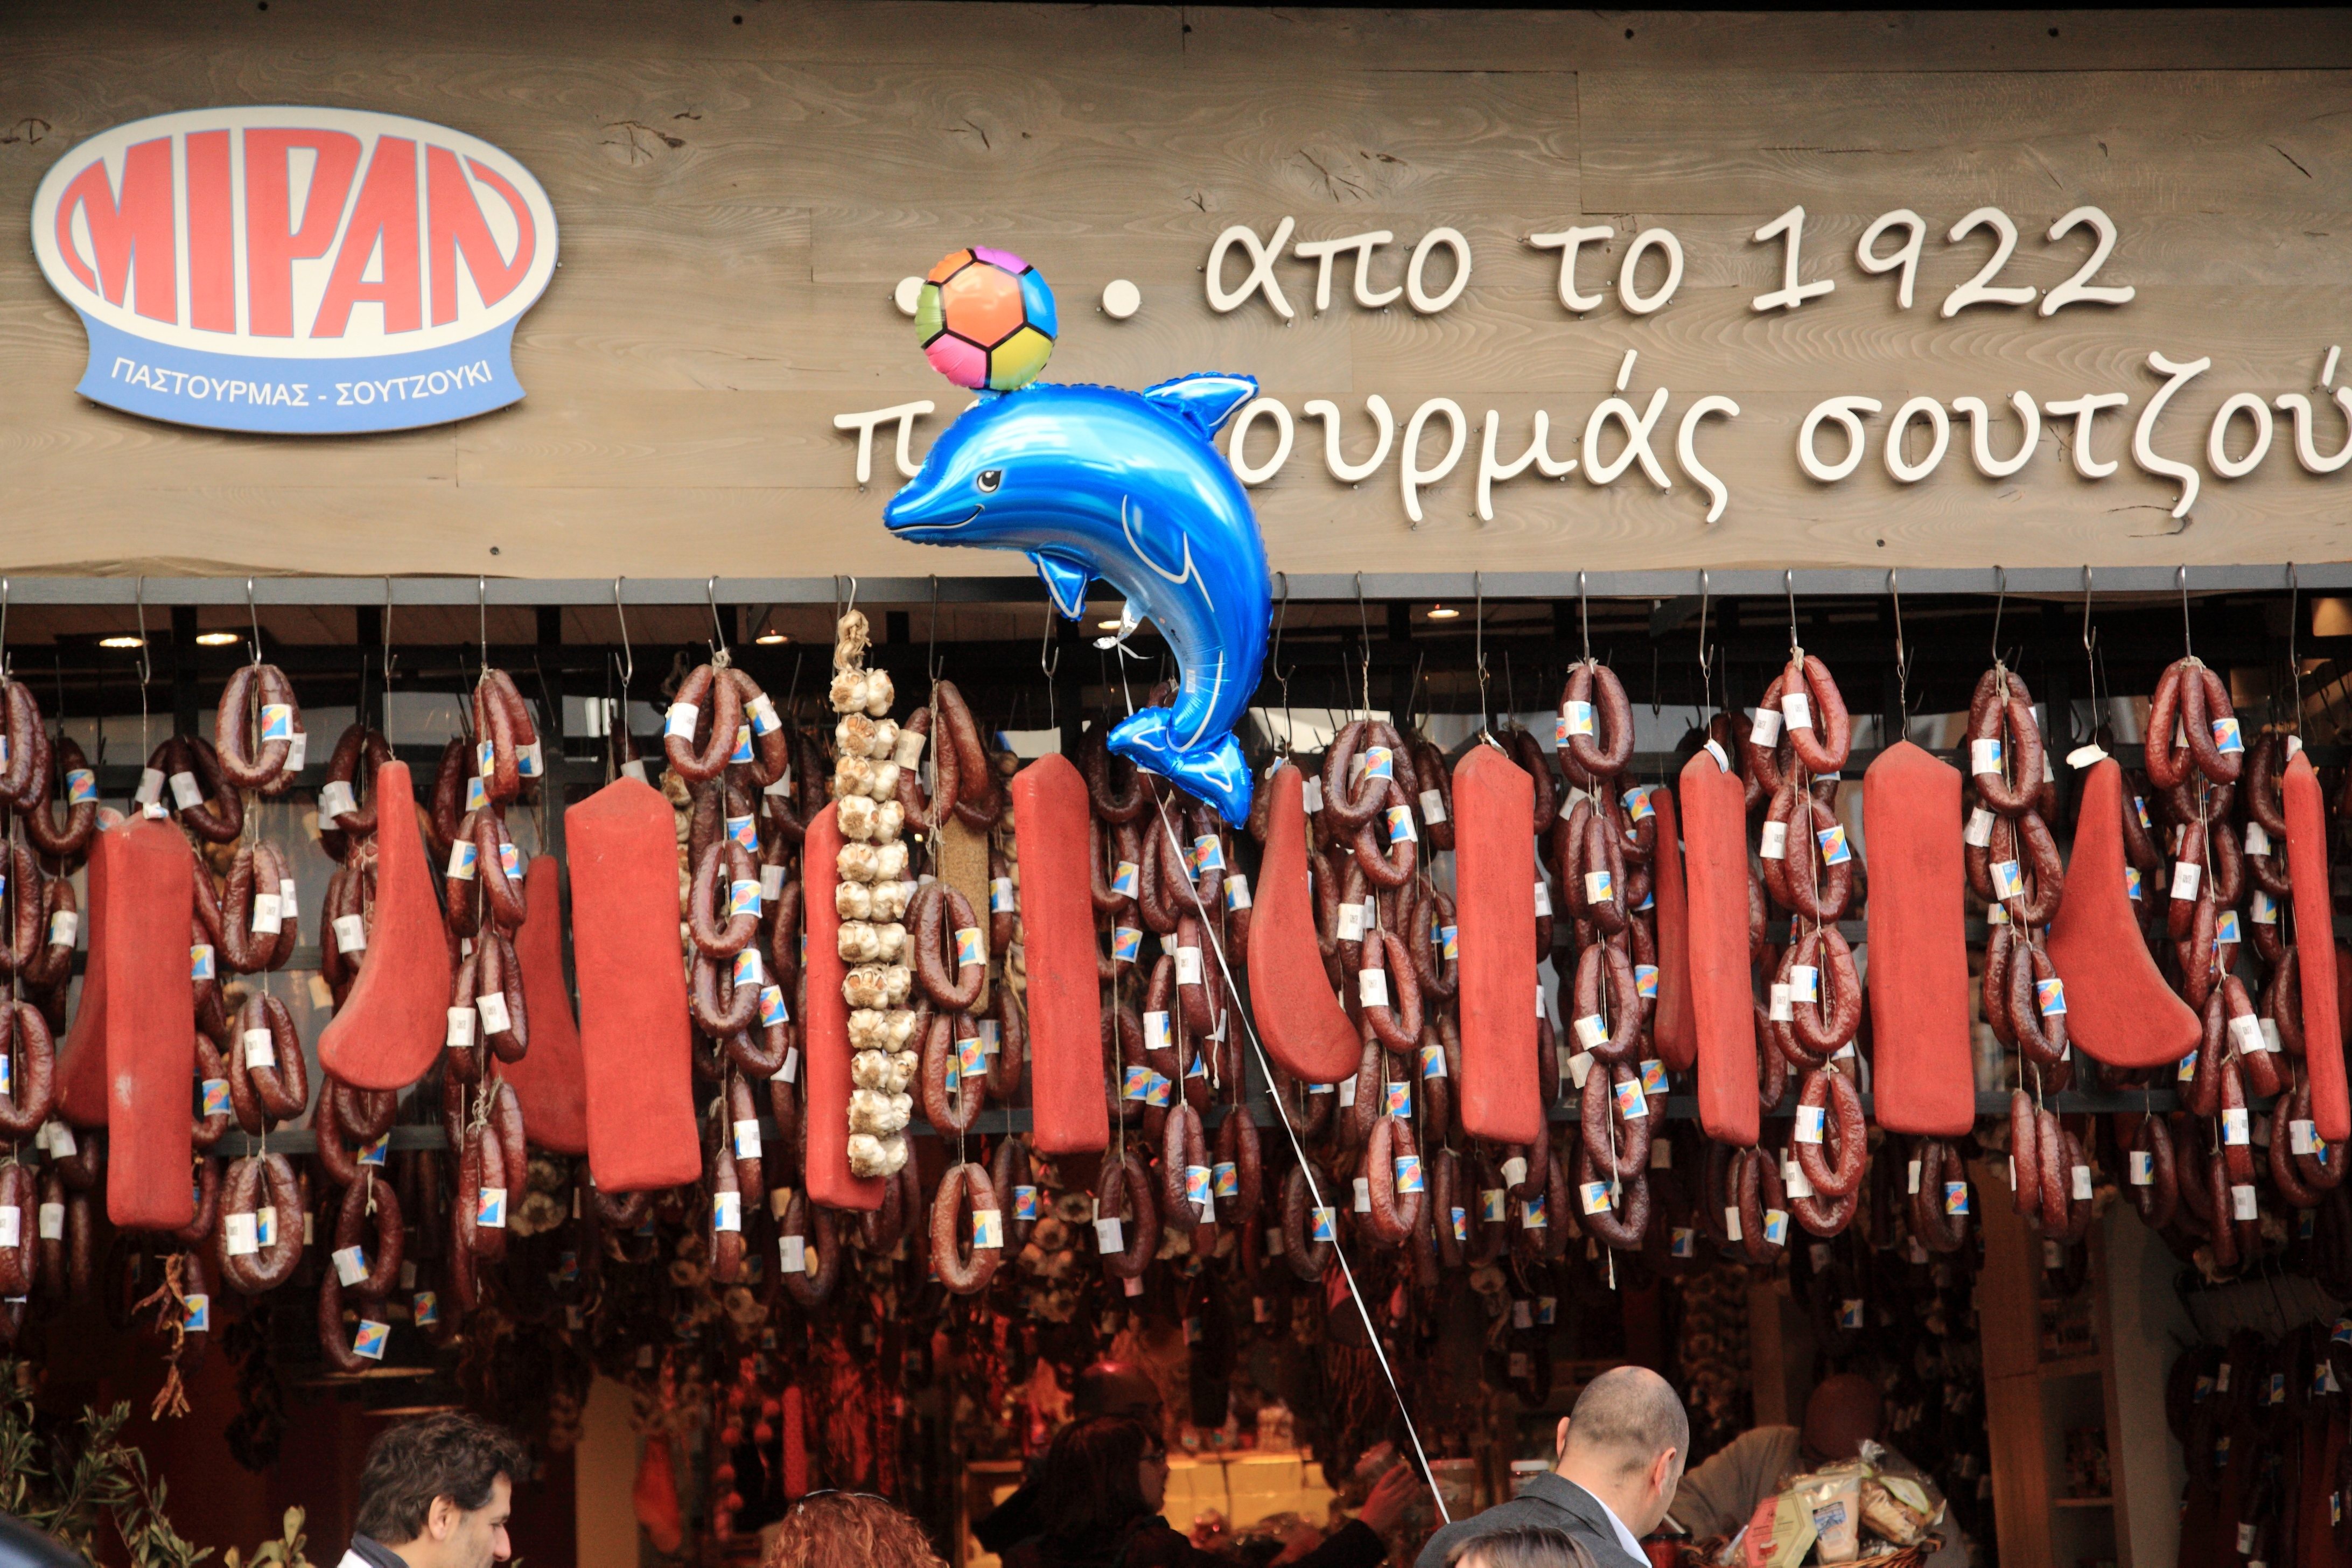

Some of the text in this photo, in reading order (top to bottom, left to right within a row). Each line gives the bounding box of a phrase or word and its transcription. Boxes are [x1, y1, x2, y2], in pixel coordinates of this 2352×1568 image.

[1206, 216, 1471, 318] απο
[1530, 226, 1684, 312] το
[1752, 206, 2135, 317] 1922
[111, 356, 310, 407] ΠΑΣΤΟΥΡΜΑΣ
[335, 360, 493, 407] ΣΟΥΤΖΟΥΚΙ
[833, 350, 1740, 523] πουρμάς
